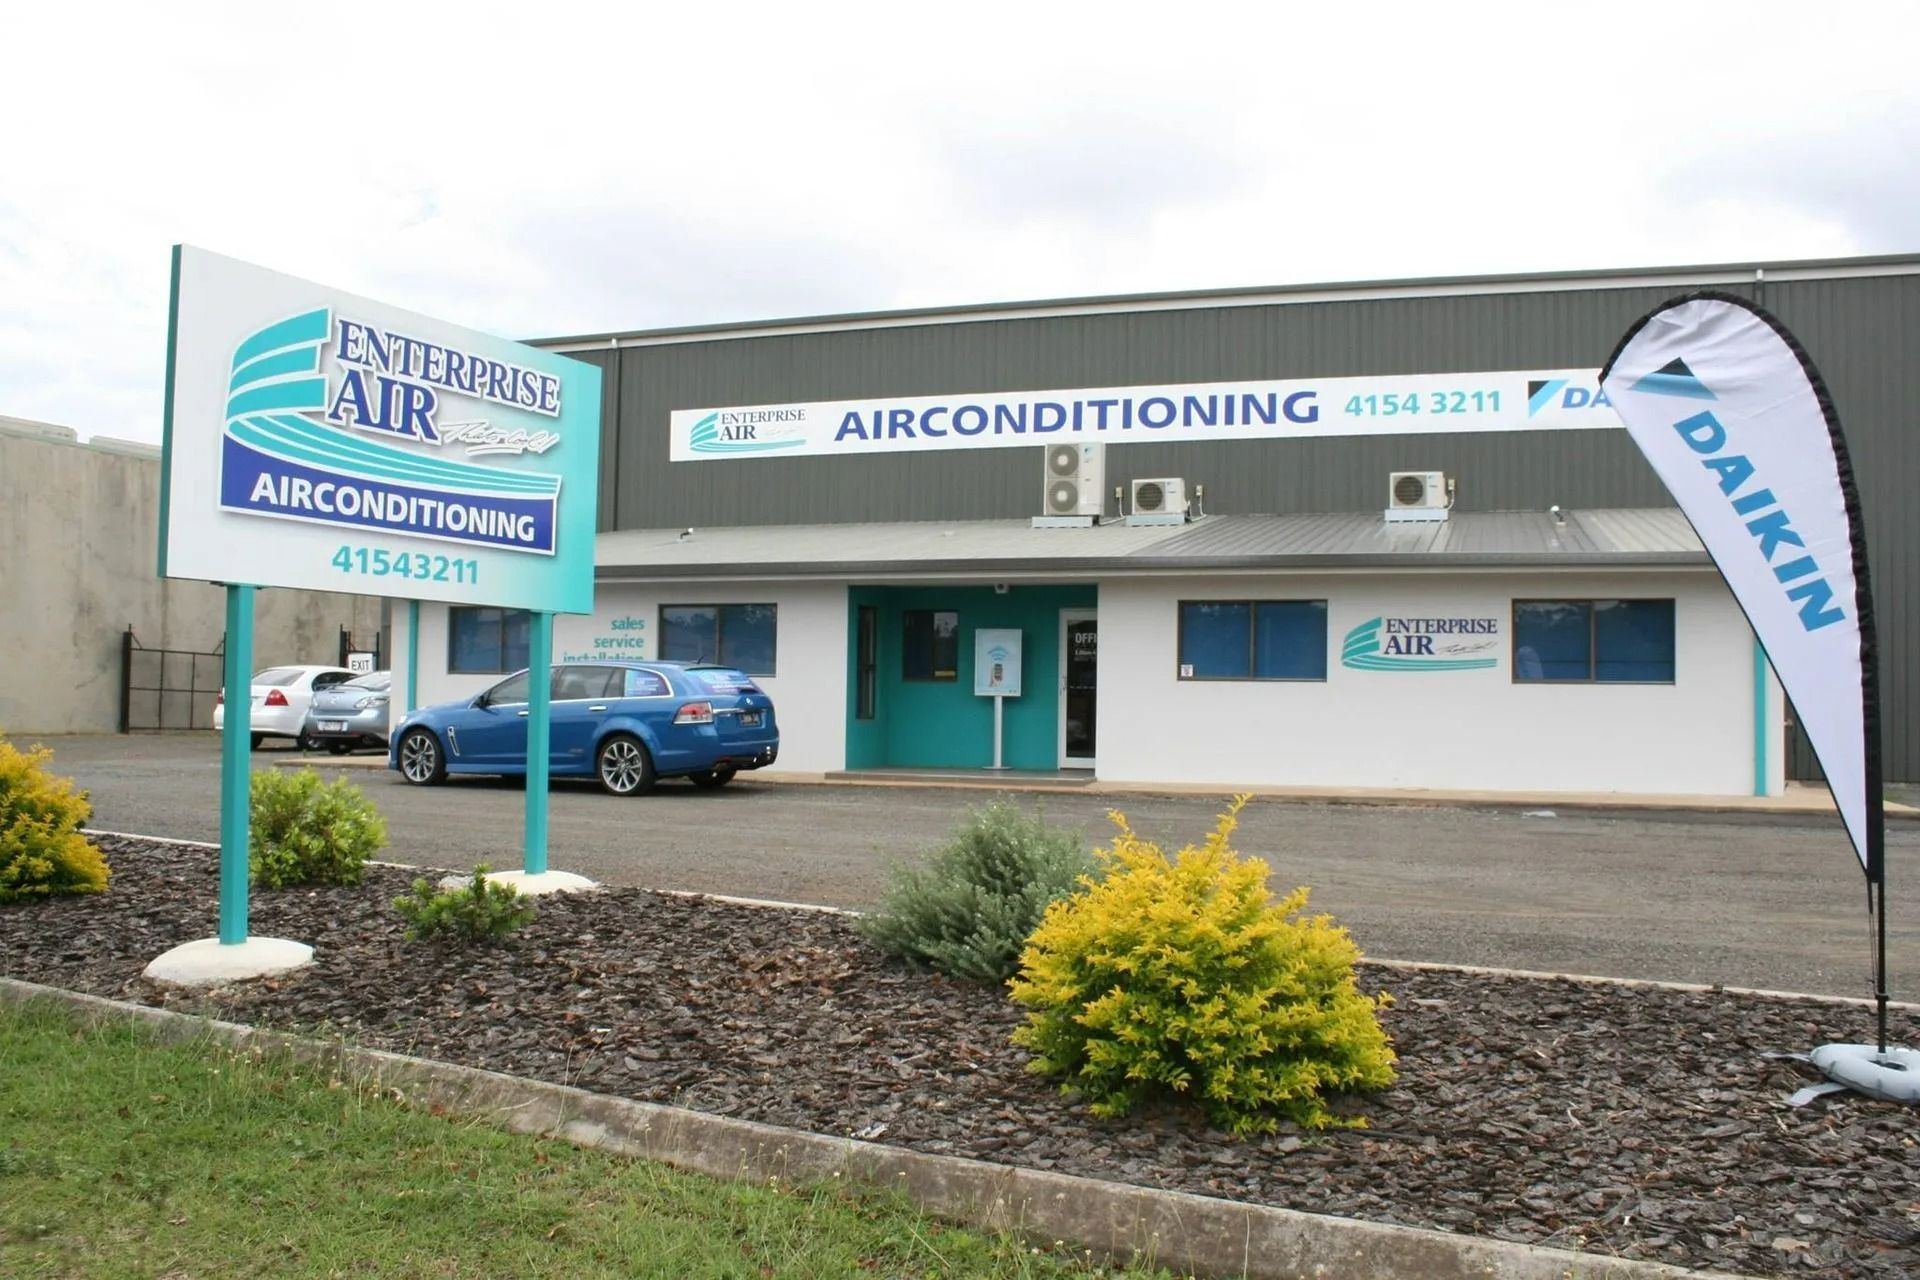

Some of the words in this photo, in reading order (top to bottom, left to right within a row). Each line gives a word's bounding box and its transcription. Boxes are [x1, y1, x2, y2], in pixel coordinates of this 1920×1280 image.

[336, 319, 559, 412] ENTERPRISE
[329, 368, 438, 441] AIR
[721, 409, 806, 425] ENTERPRISE
[834, 391, 1319, 442] AIRCONDITIONING
[1344, 391, 1421, 417] 4154
[1429, 390, 1500, 413] 3211
[719, 425, 757, 441] AIR
[250, 472, 535, 542] AIRCONDITIONING
[1673, 410, 1846, 632] DAIKIN
[332, 545, 478, 584] 41543211
[611, 616, 645, 630] sales
[1386, 618, 1497, 634] ENTERPRISE
[593, 634, 644, 648] service
[1384, 635, 1435, 655] AIR
[351, 660, 370, 671] EXIT
